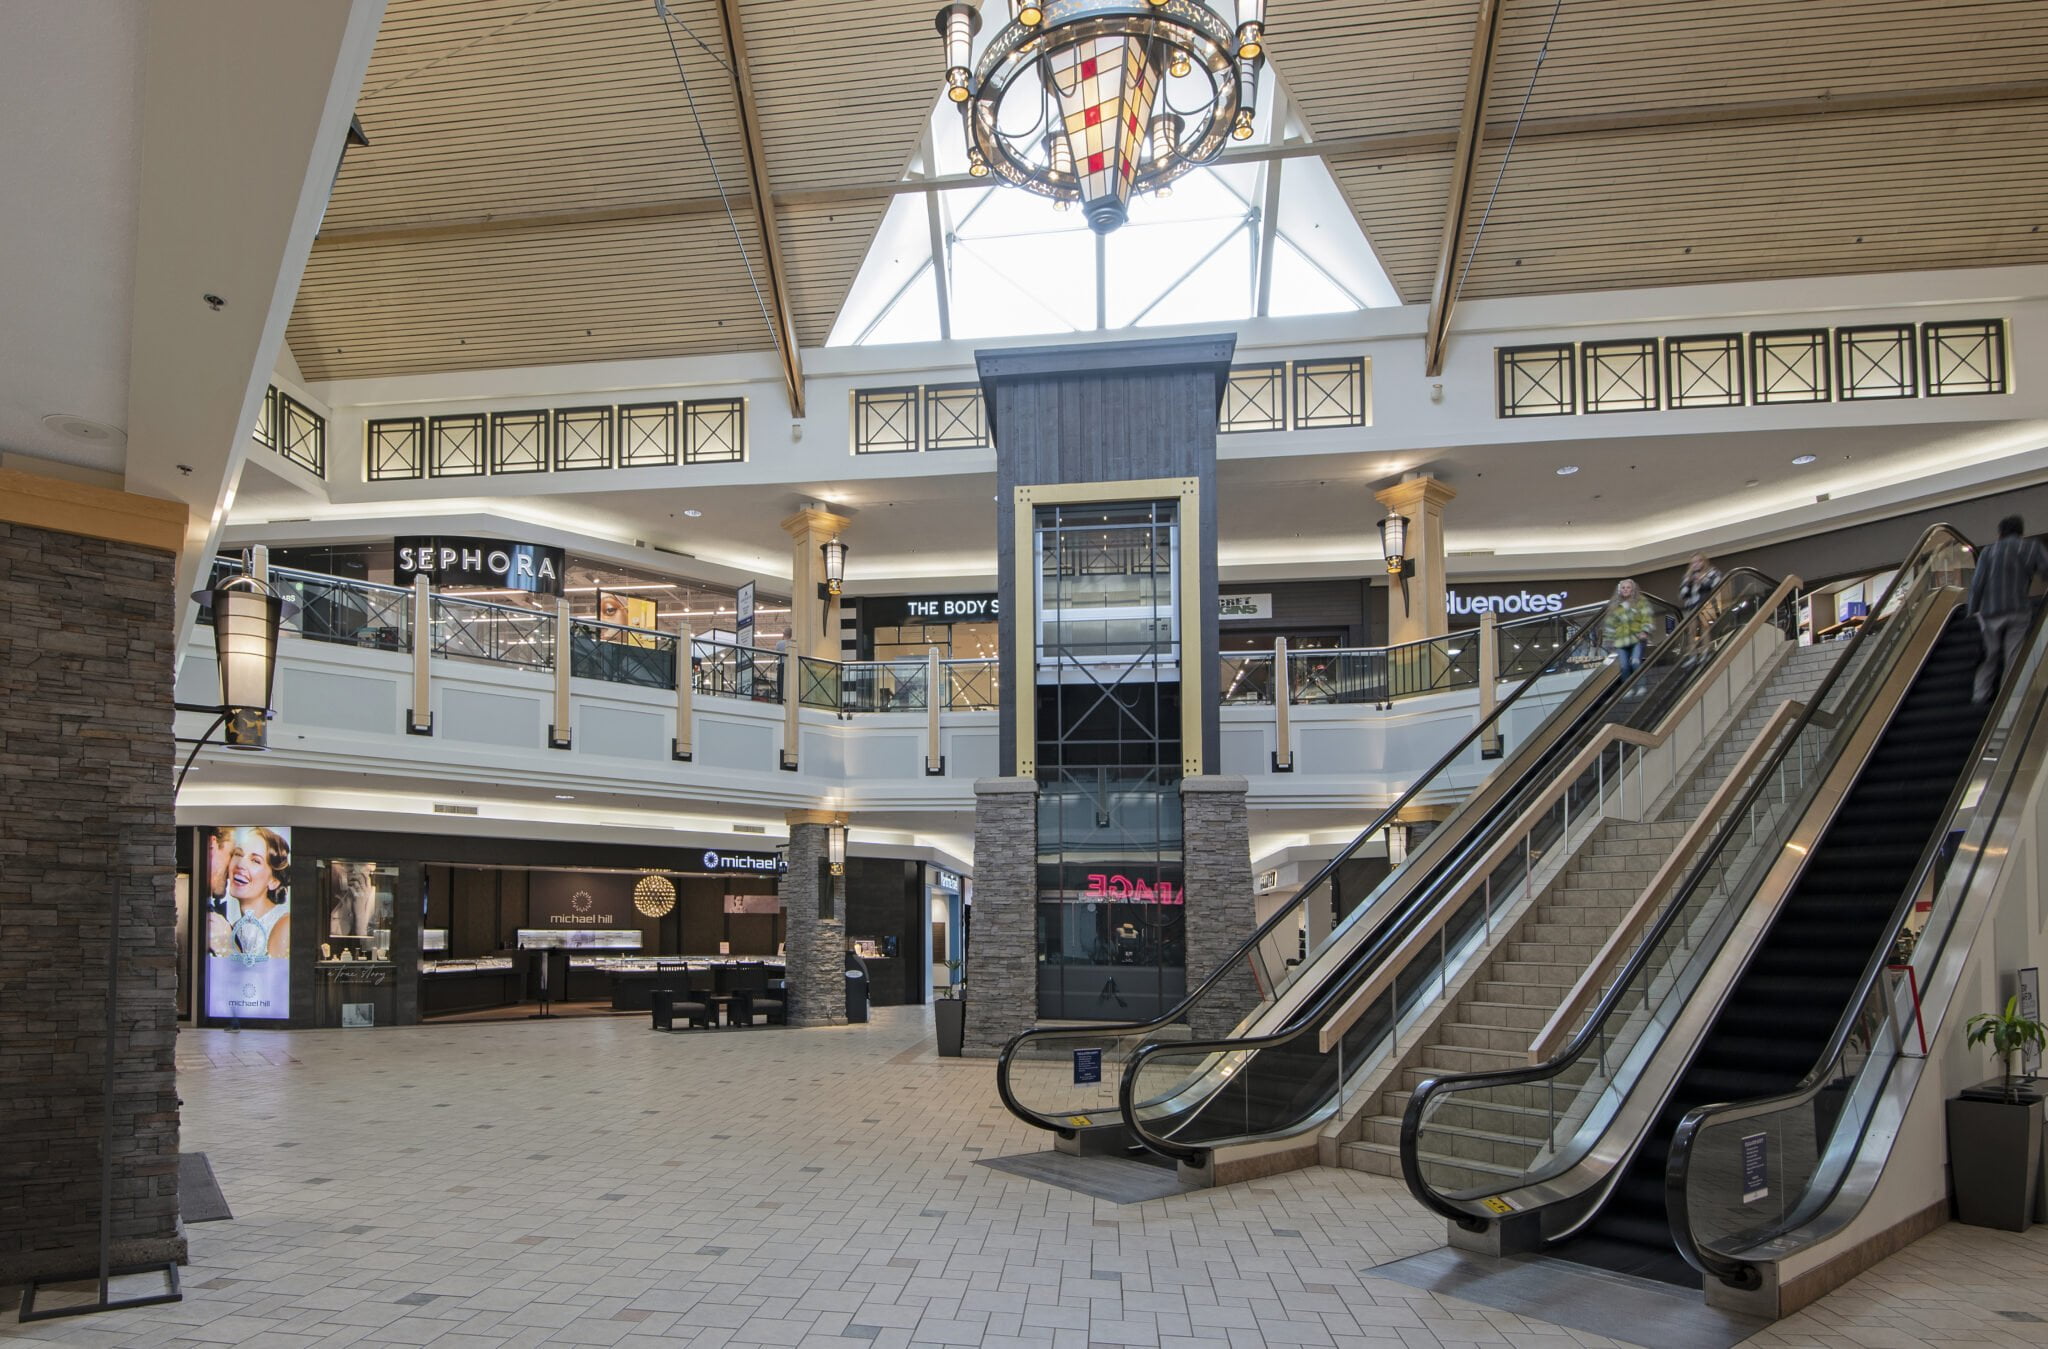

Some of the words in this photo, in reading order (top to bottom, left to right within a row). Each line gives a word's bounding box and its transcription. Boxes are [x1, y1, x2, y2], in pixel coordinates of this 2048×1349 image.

[400, 547, 556, 580] SEPHORA
[908, 601, 939, 616] THE
[944, 600, 987, 615] BODY
[1446, 590, 1567, 614] luenotes'
[721, 855, 776, 870] michael
[550, 914, 596, 924] michael
[598, 914, 613, 924] hill
